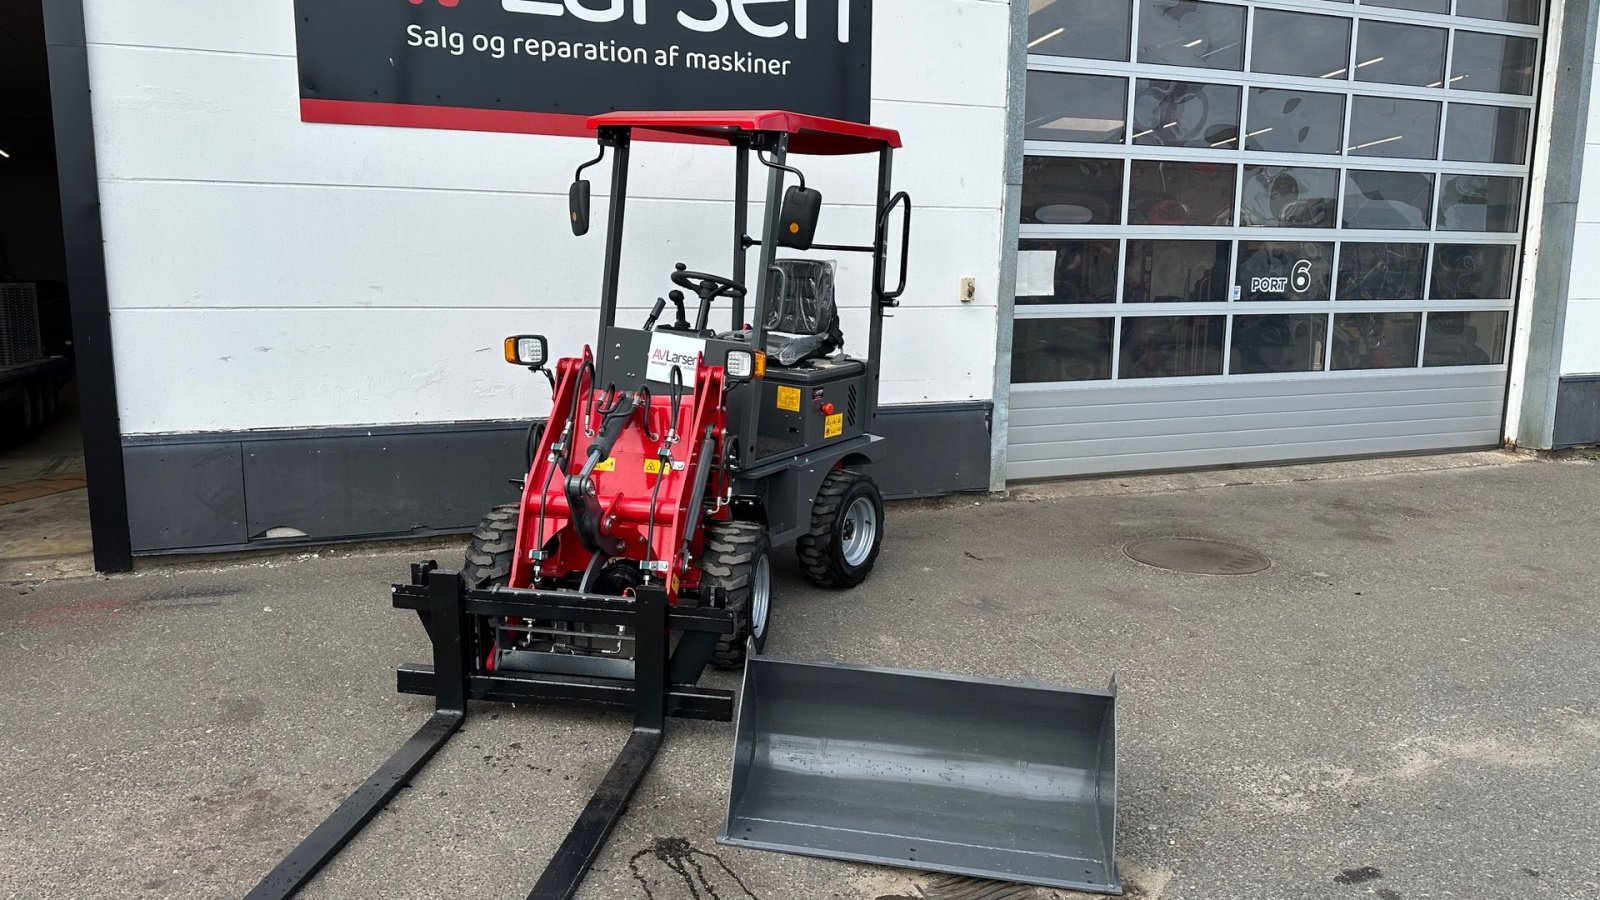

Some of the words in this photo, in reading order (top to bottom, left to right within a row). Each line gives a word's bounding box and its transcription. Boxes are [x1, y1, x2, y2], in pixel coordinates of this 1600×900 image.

[406, 24, 465, 56] Salg
[472, 34, 505, 59] og
[513, 37, 648, 65] reparation
[654, 45, 680, 67] af
[686, 51, 791, 76] maskiner
[1251, 277, 1288, 293] PORT
[1291, 259, 1313, 293] 6
